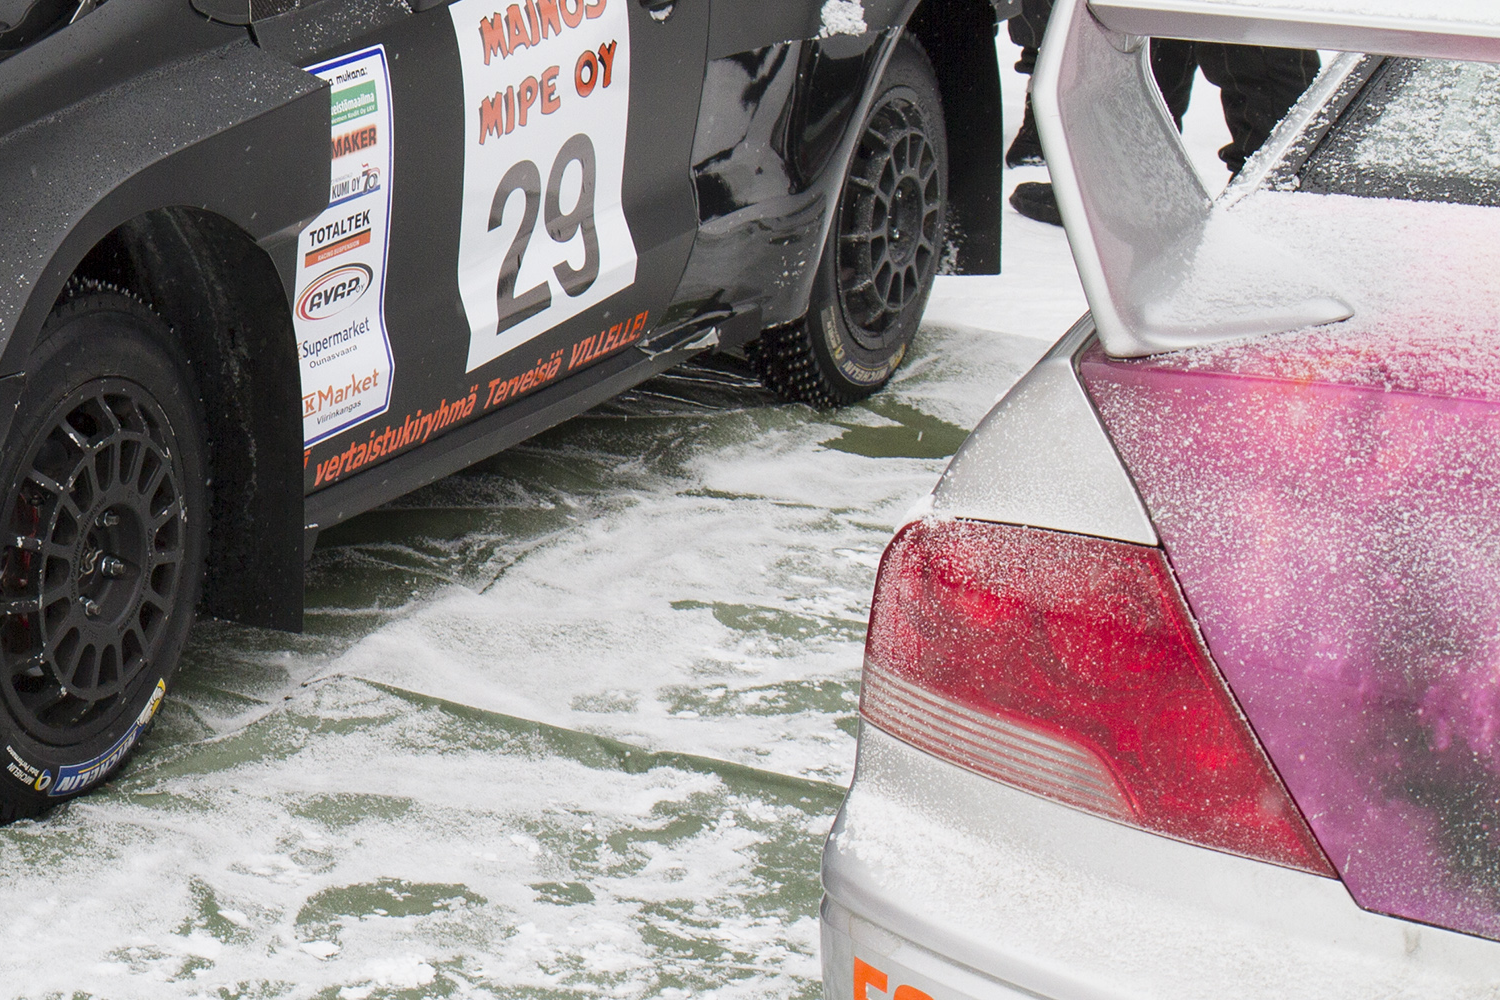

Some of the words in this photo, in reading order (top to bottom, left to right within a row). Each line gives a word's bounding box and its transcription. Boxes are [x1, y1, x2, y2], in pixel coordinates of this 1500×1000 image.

[336, 67, 368, 84] mukana:
[478, 65, 561, 145] MIPE
[574, 39, 617, 98] OY
[331, 127, 377, 159] MAKER
[331, 180, 349, 200] KUMI
[351, 175, 361, 192] OY
[309, 209, 371, 247] TOTALTEK
[487, 133, 601, 336] 29
[317, 248, 334, 262] RACING
[334, 239, 360, 255] SUSPENSION
[302, 317, 370, 358] Supermarket
[309, 343, 358, 369] Ounasvaara
[314, 384, 479, 486] vertaistukiryhmä
[483, 348, 564, 410] Terveisiä
[567, 310, 649, 371] VILLELLE!
[316, 400, 362, 425] Viirinkangas
[6, 762, 35, 786] MICHELIN
[55, 730, 139, 792] MICHELIN
